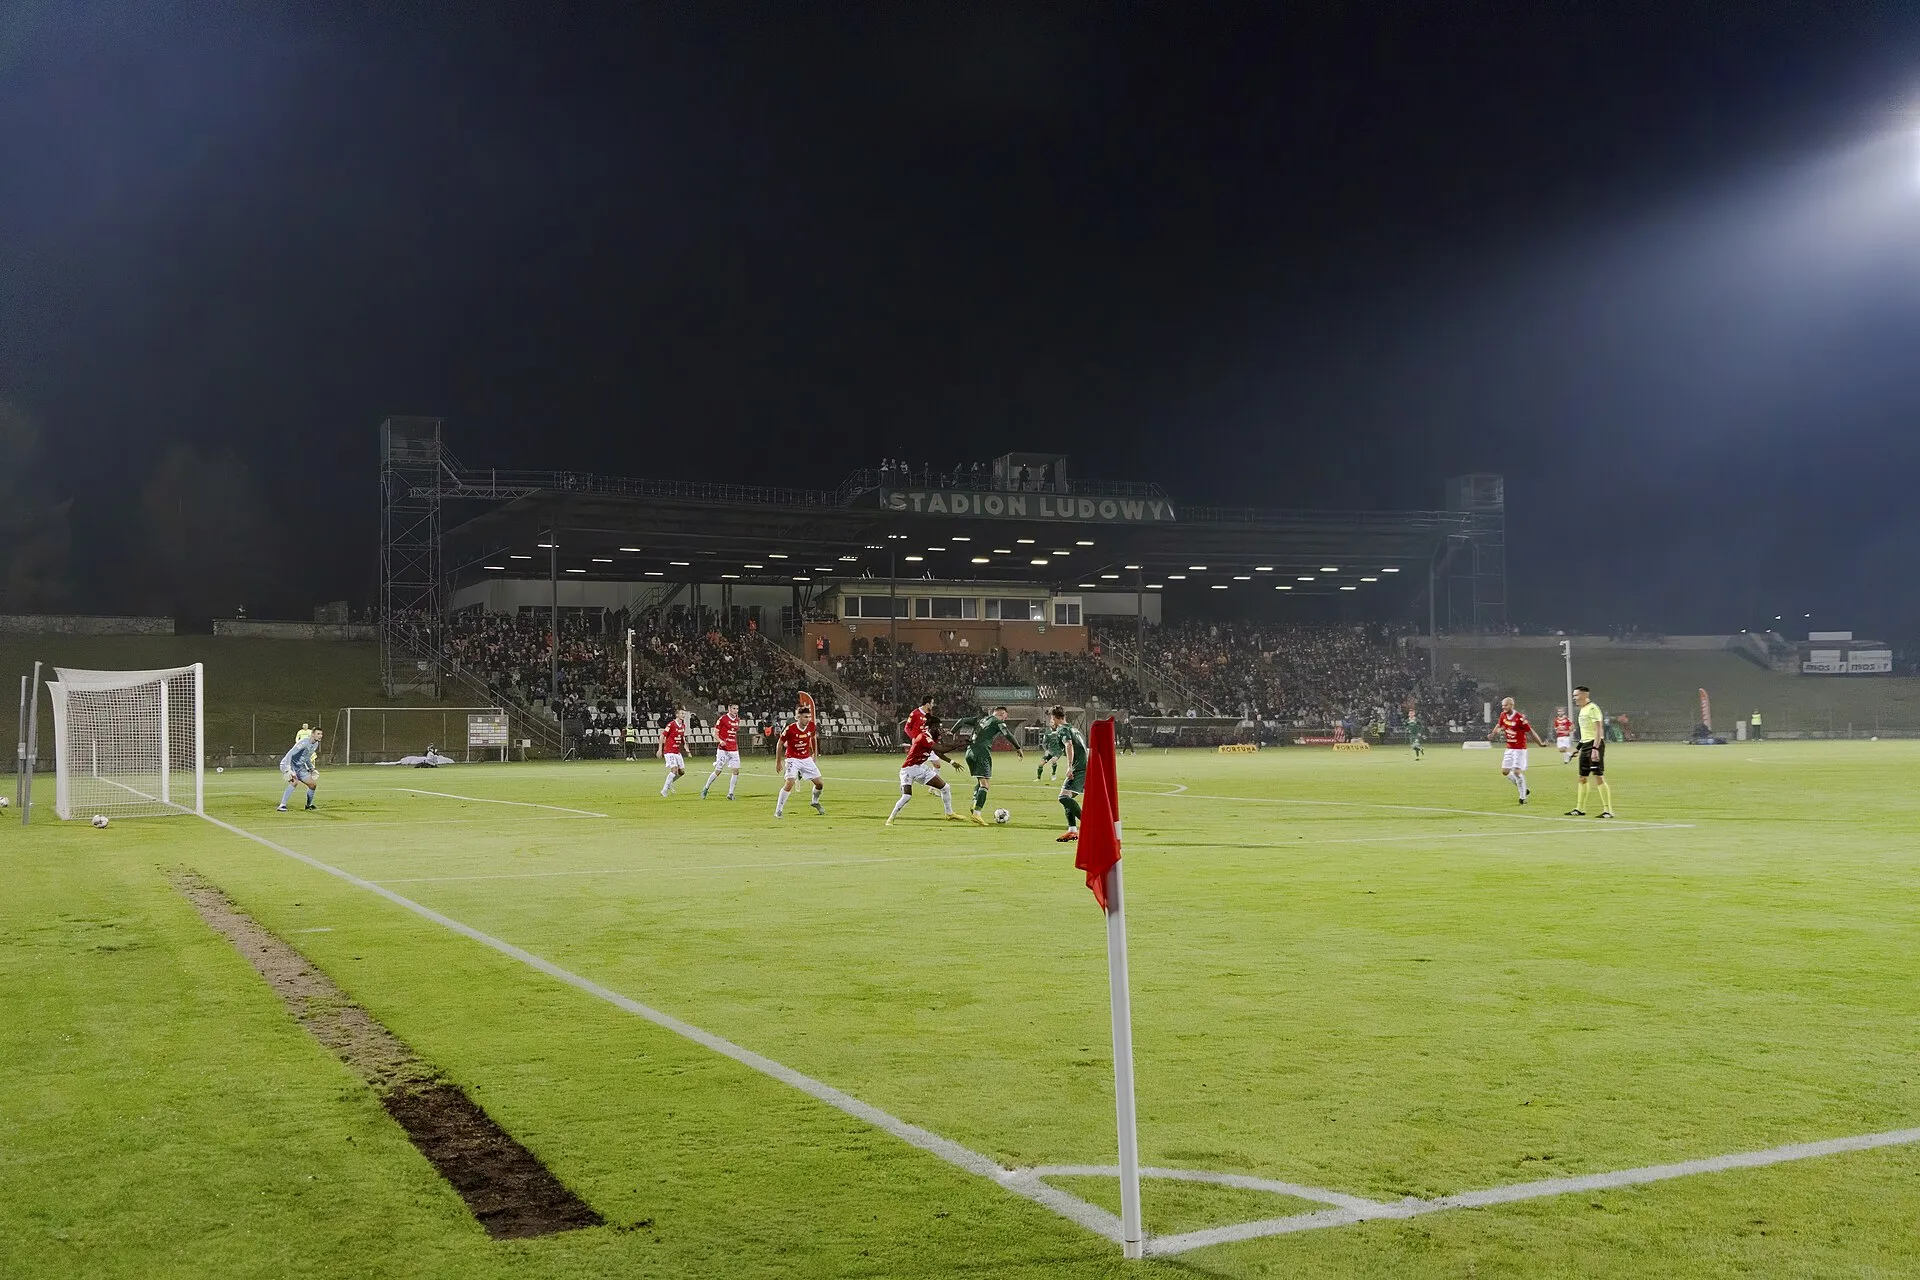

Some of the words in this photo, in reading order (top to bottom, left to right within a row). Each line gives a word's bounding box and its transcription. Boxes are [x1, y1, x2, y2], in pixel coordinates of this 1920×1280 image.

[889, 492, 1027, 516] STADION
[1039, 497, 1164, 521] LUDOWY
[755, 736, 761, 744] 7
